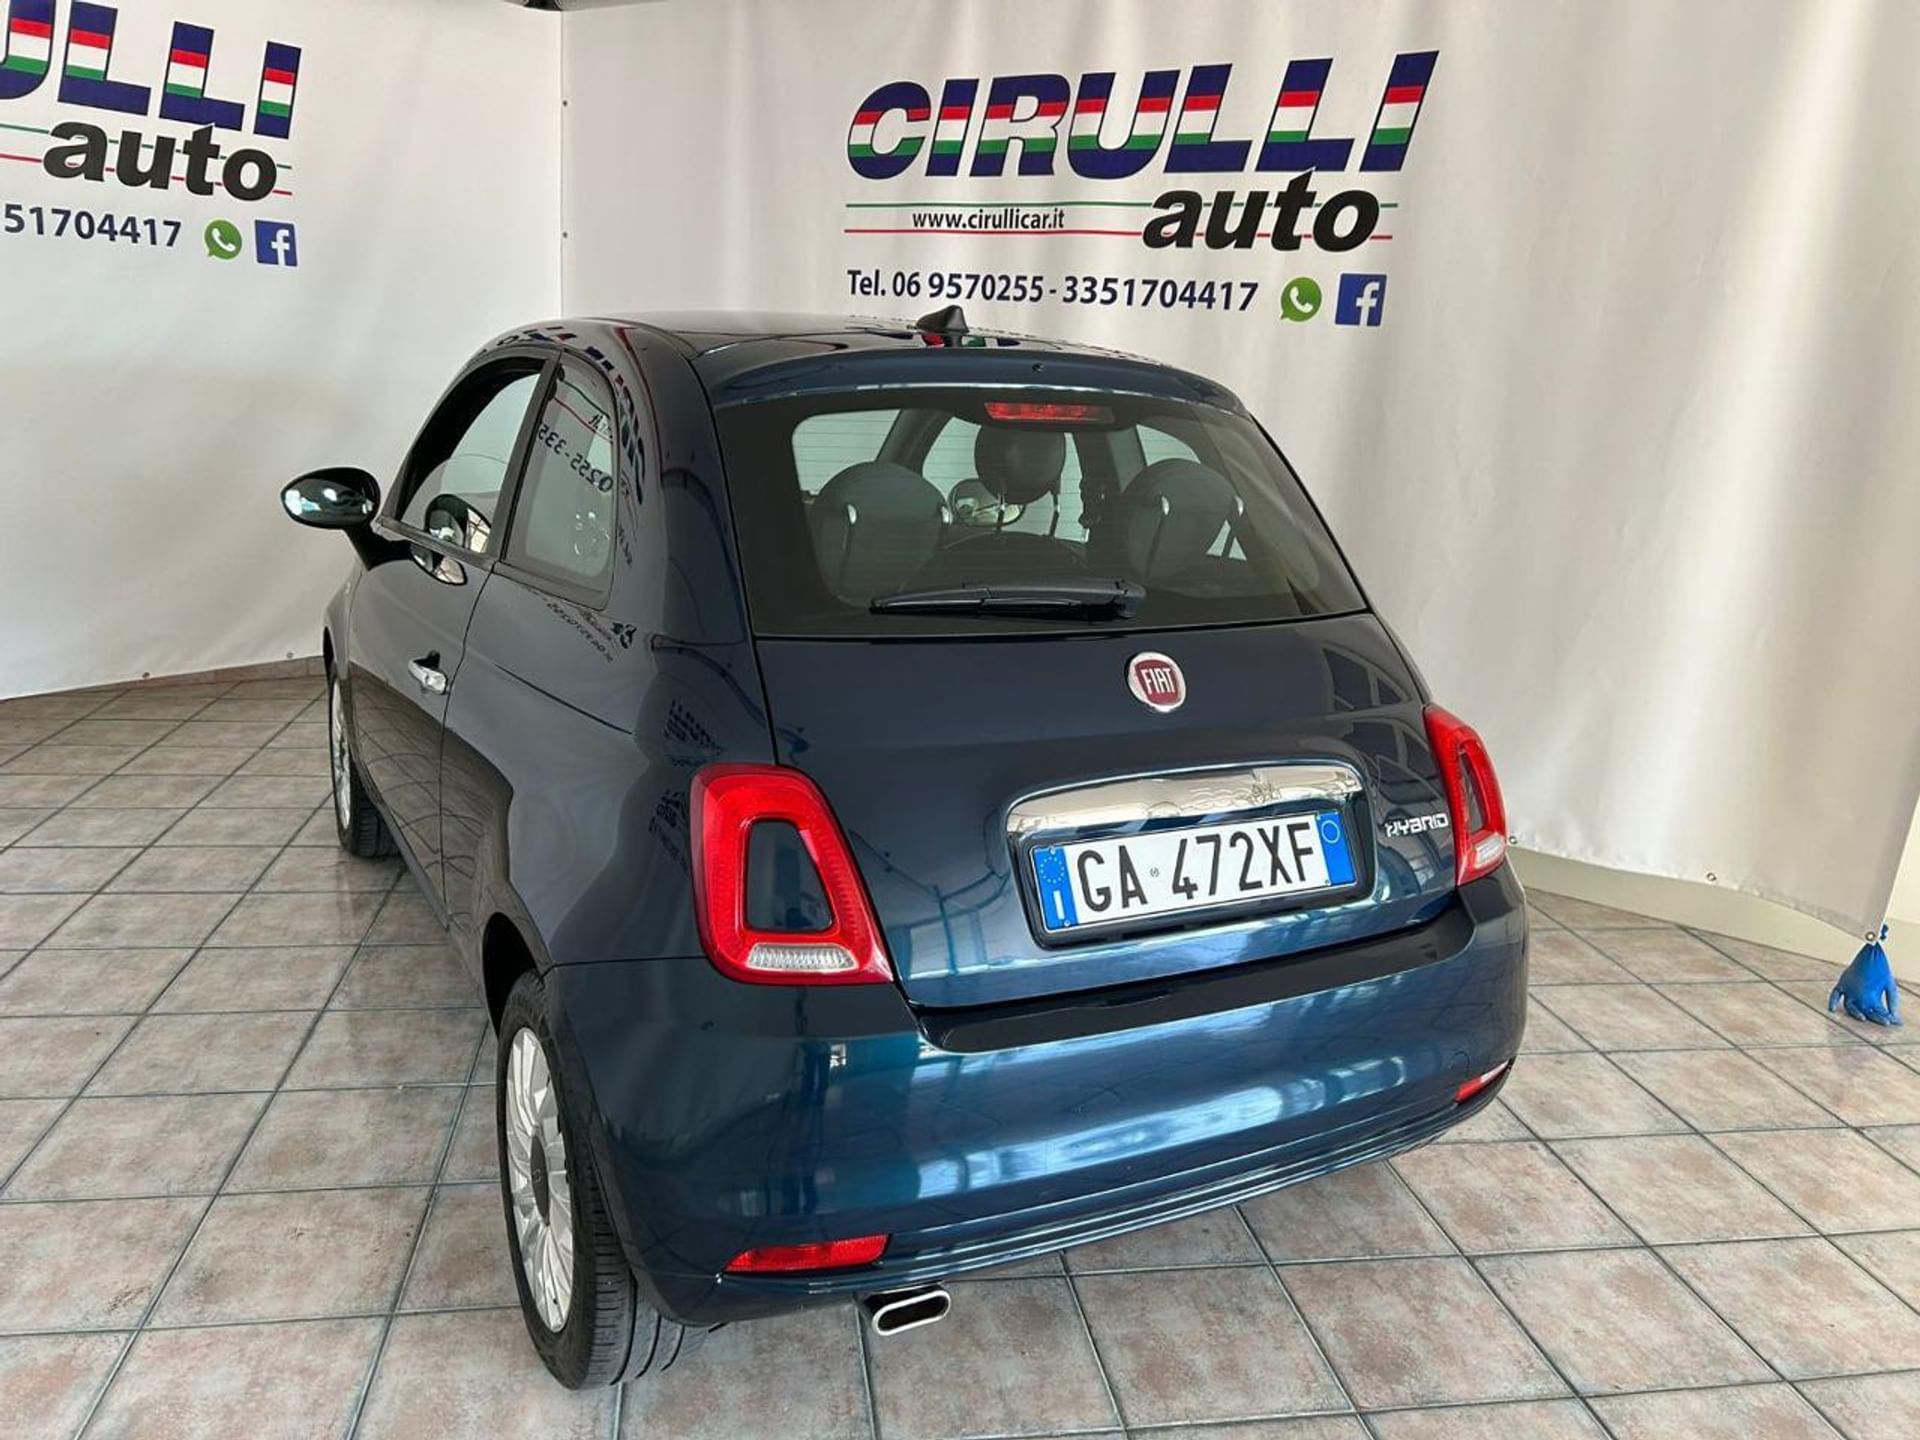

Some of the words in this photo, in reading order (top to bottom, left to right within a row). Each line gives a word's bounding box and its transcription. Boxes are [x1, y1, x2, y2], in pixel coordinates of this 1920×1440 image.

[847, 50, 1439, 180] CIRULLI
[43, 121, 277, 201] auto
[4, 203, 182, 247] 51704417
[912, 208, 1065, 229] www.cirullicar.it
[1143, 168, 1379, 252] auto
[847, 269, 886, 296] Tel.
[892, 271, 921, 298] 06
[1140, 667, 1176, 695] FIAT
[1384, 813, 1449, 838] HYBRID
[1076, 845, 1148, 912] GA
[1171, 822, 1315, 900] 472XF
